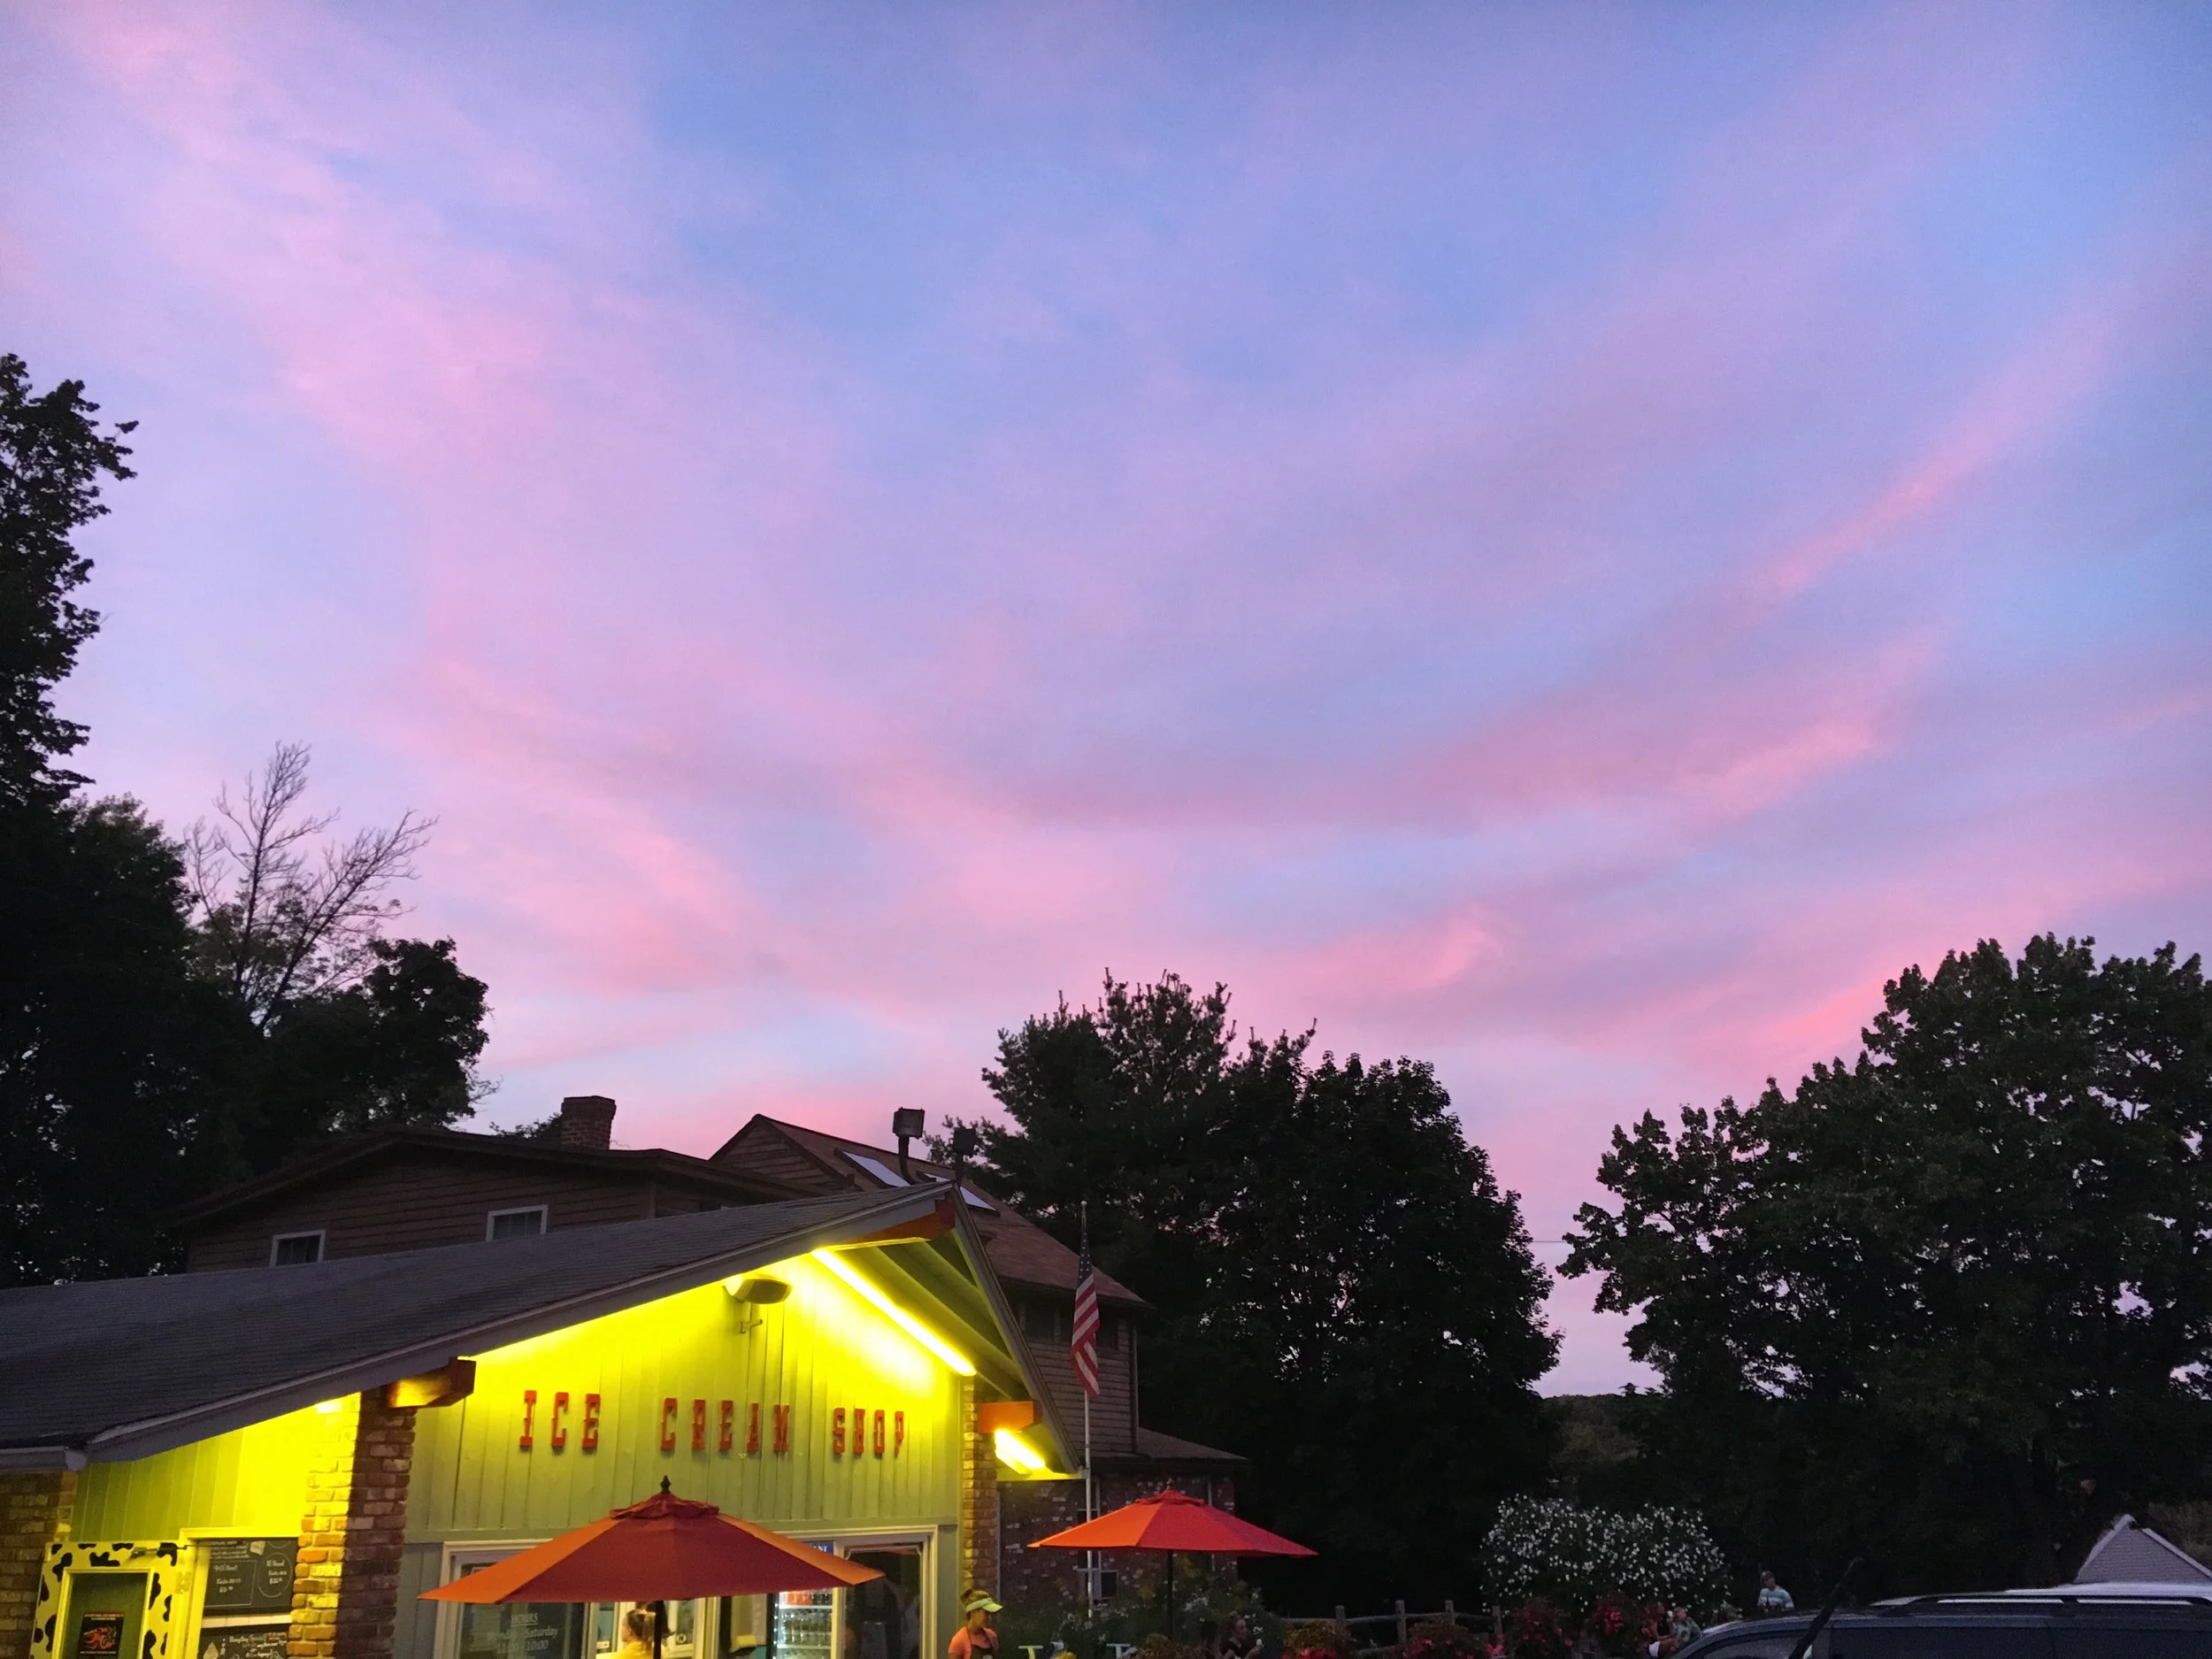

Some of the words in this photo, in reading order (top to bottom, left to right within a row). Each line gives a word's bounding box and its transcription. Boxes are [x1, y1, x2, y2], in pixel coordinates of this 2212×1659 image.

[519, 1390, 601, 1448] ICE
[660, 1397, 790, 1452] CREAM
[833, 1407, 904, 1455] SHOP
